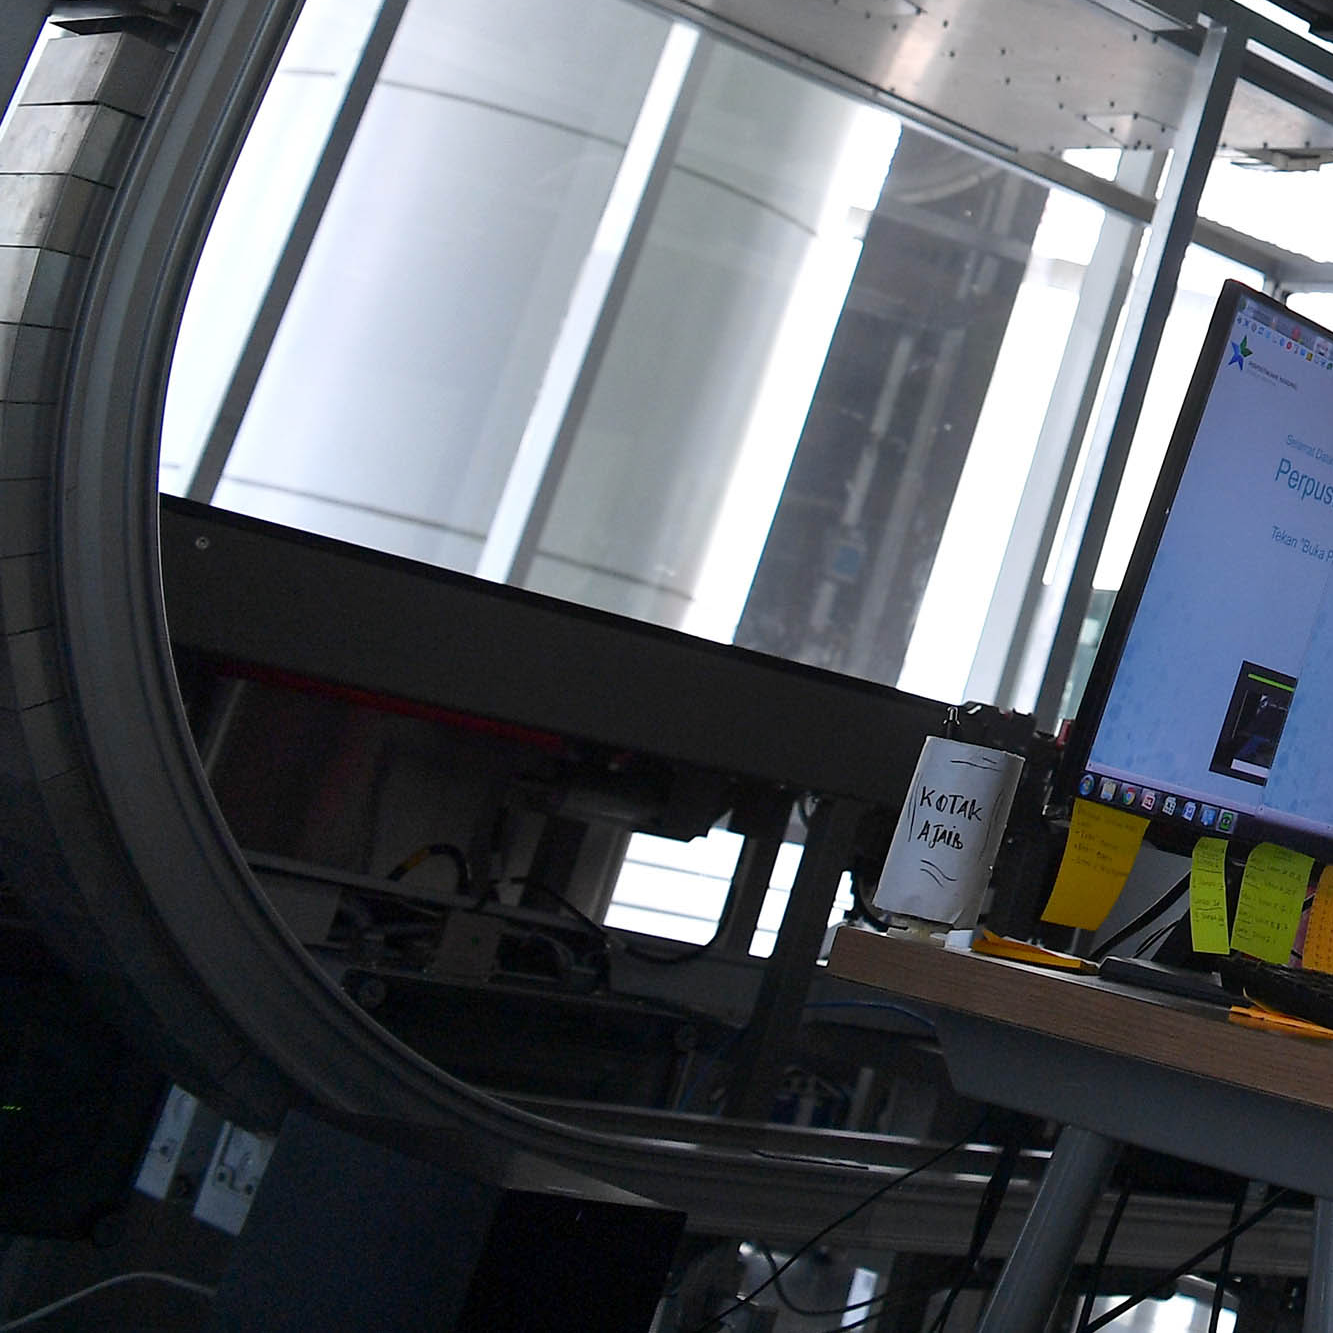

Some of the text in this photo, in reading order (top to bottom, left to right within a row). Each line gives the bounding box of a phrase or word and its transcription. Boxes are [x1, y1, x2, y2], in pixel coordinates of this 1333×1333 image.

[1271, 525, 1298, 549] Tekan
[920, 786, 983, 821] KOTAK
[917, 820, 964, 850] AJAIB
